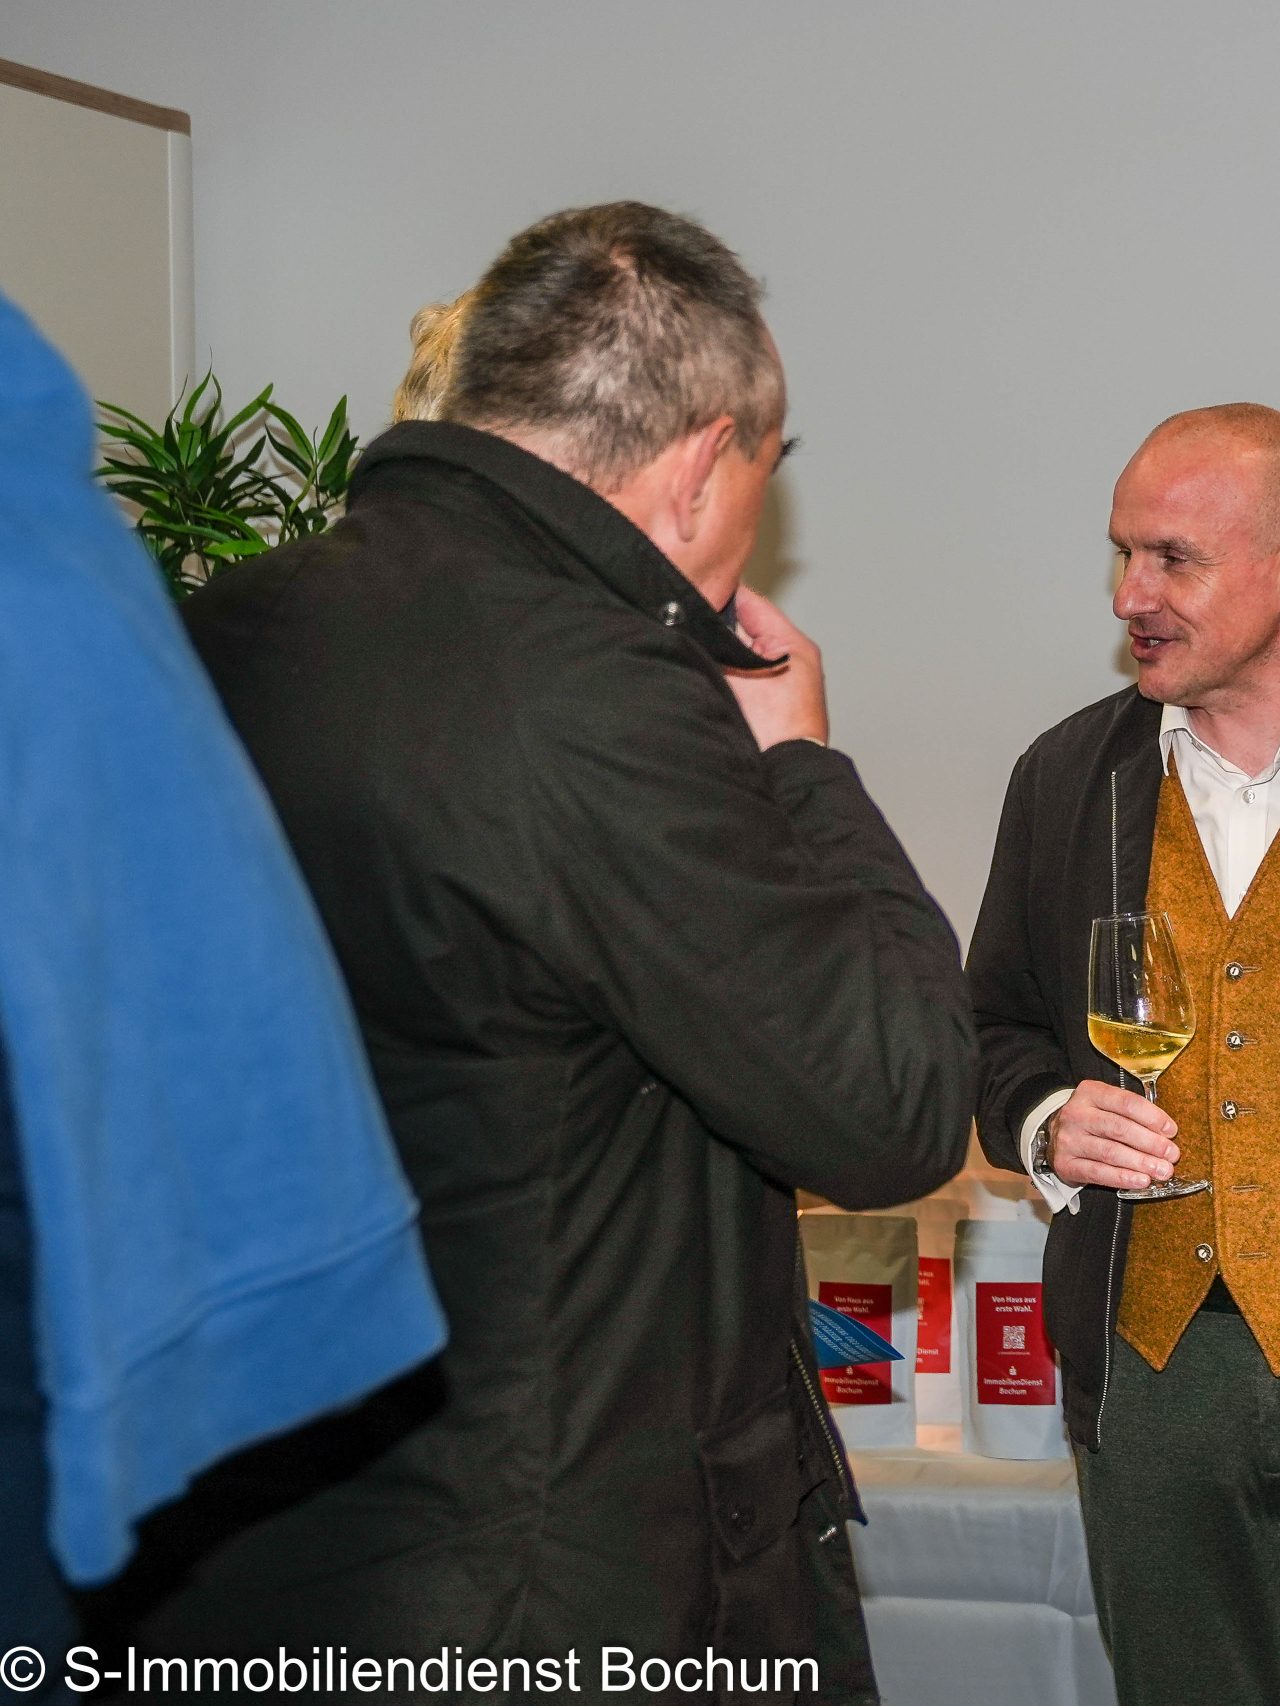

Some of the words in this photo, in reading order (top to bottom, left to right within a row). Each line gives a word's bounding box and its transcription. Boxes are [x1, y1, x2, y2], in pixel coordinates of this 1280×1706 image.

[1006, 1296, 1023, 1304] Haus
[1013, 1305, 1033, 1313] Wahl.
[984, 1378, 1043, 1387] ImmobilienDienst
[836, 1386, 863, 1395] Bochum
[999, 1387, 1027, 1395] Bochum
